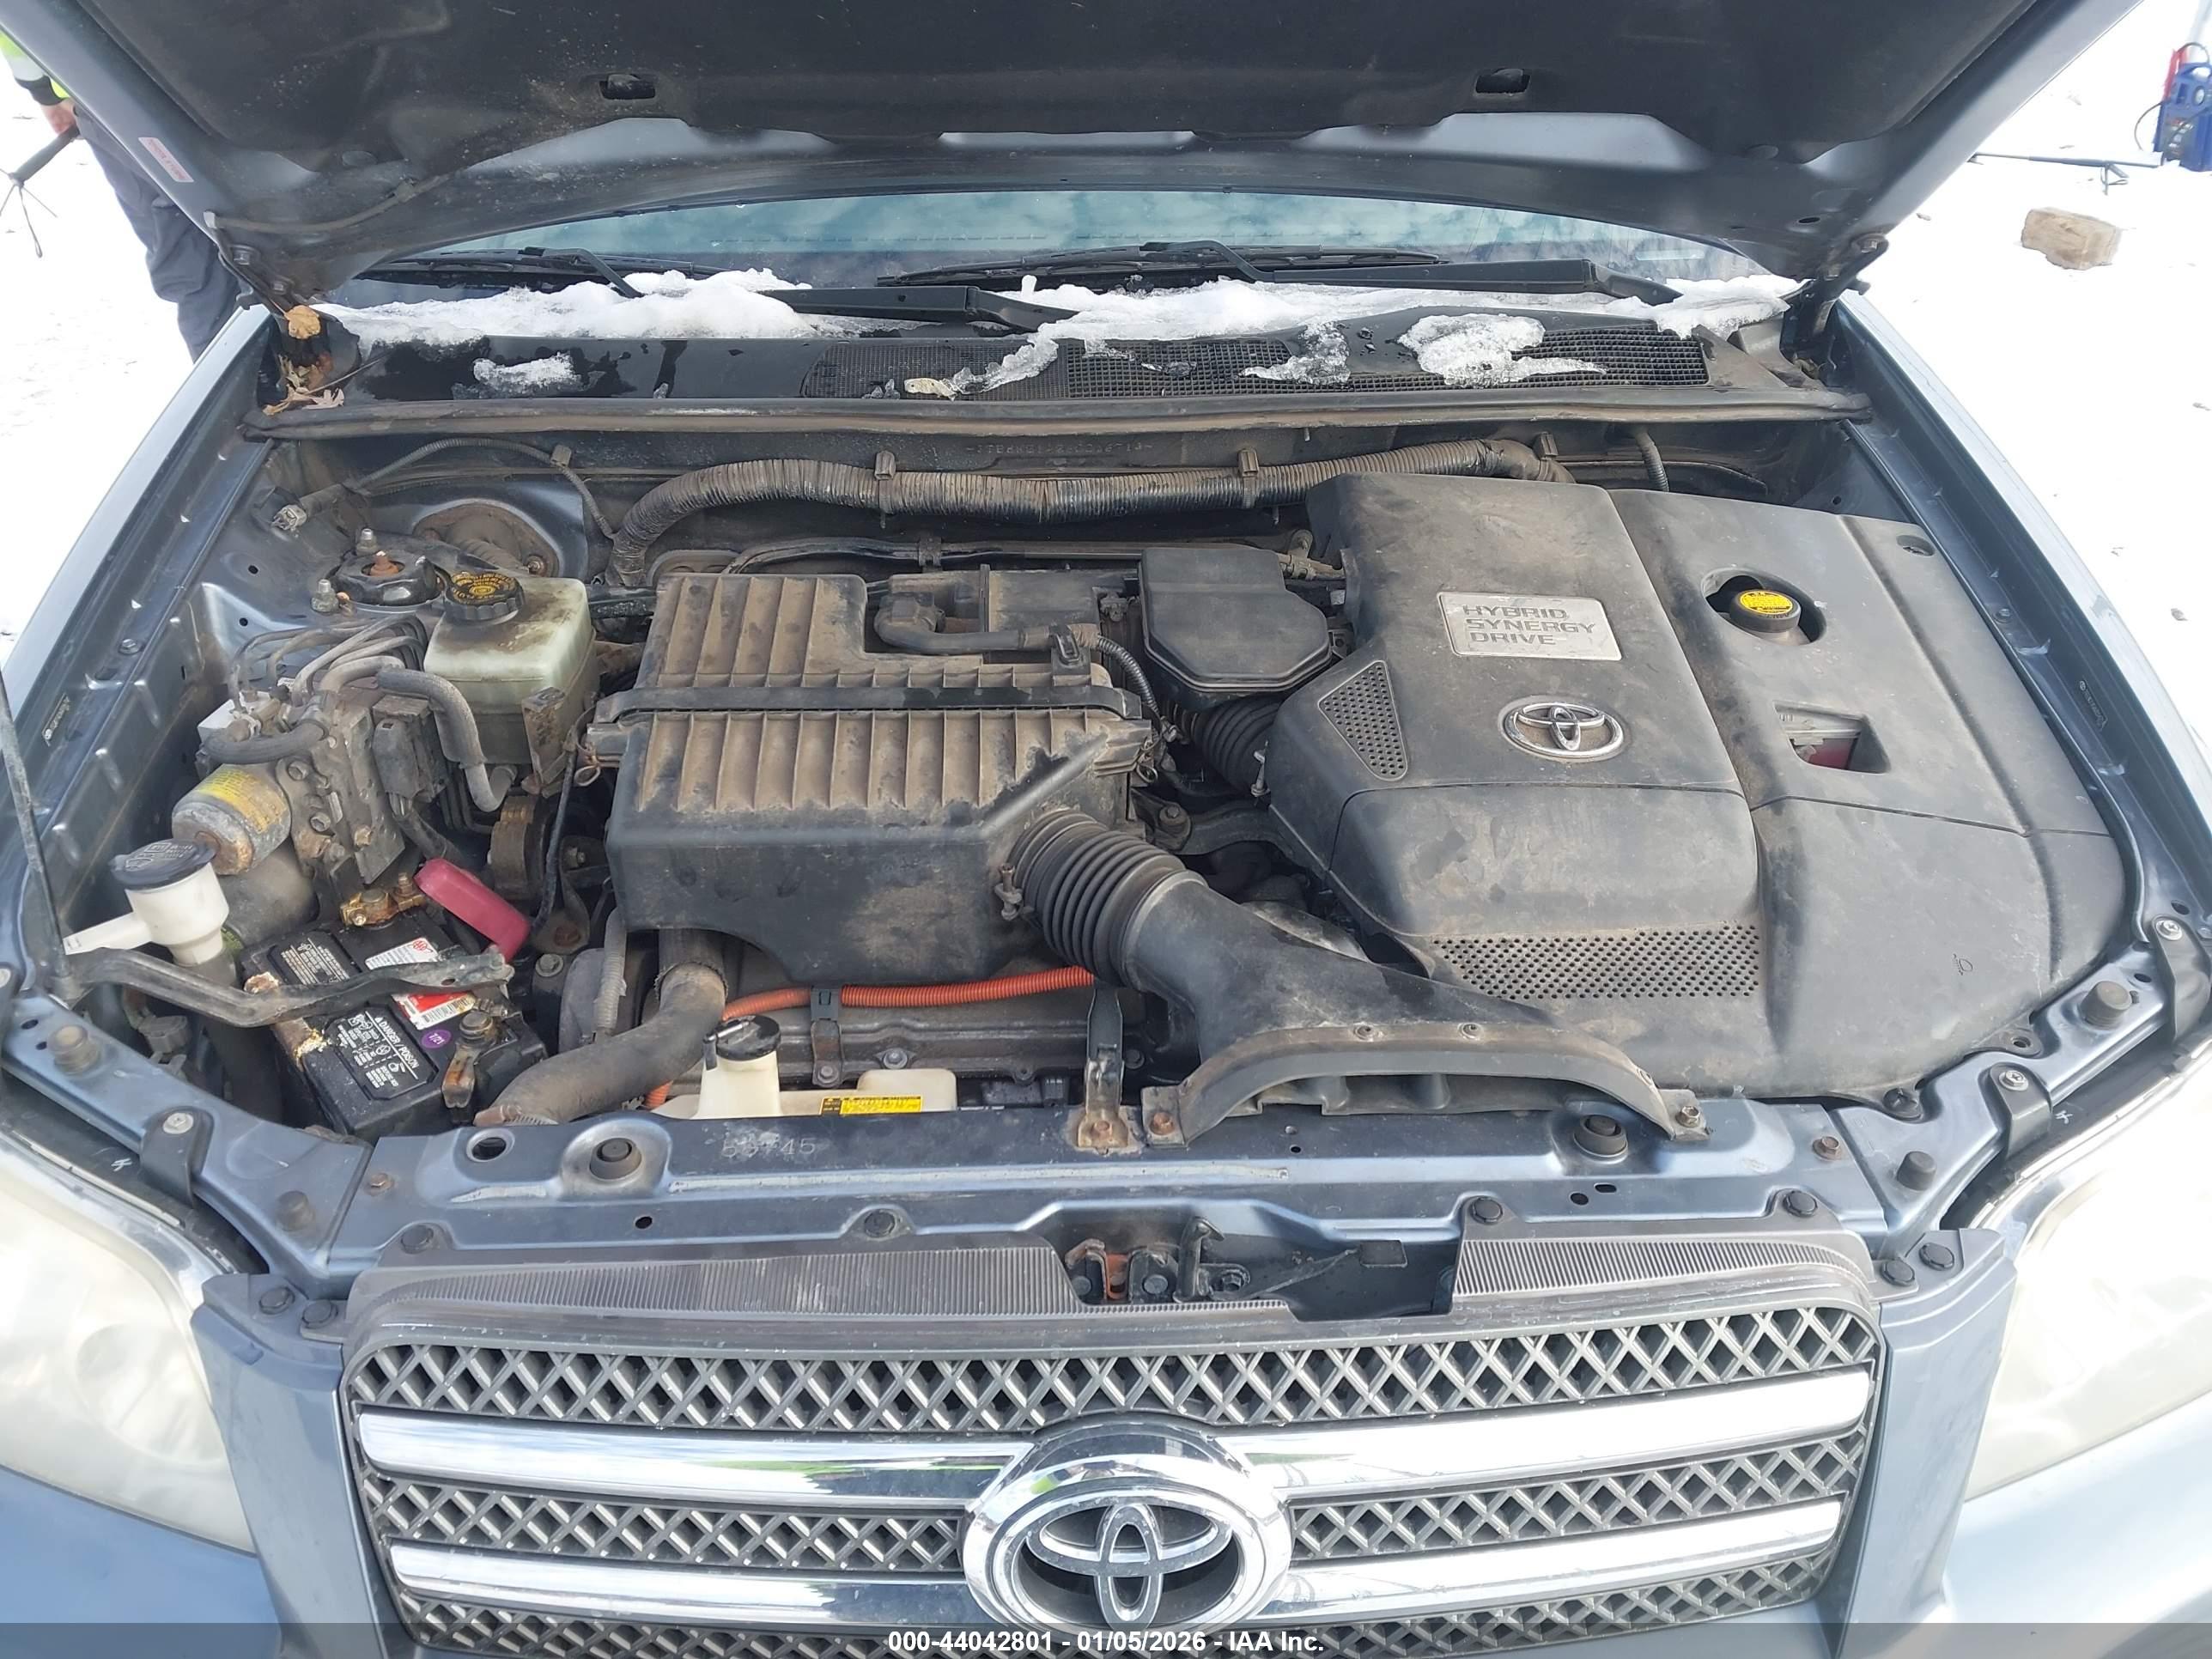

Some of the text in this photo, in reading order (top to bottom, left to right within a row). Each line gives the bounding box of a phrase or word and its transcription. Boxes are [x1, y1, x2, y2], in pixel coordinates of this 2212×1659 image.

[1462, 605, 1568, 619] HYBRID
[1465, 618, 1595, 634] SYNERGY
[1470, 632, 1556, 646] DRIVE
[379, 1021, 402, 1045] DANGER
[398, 1046, 420, 1069] POISON
